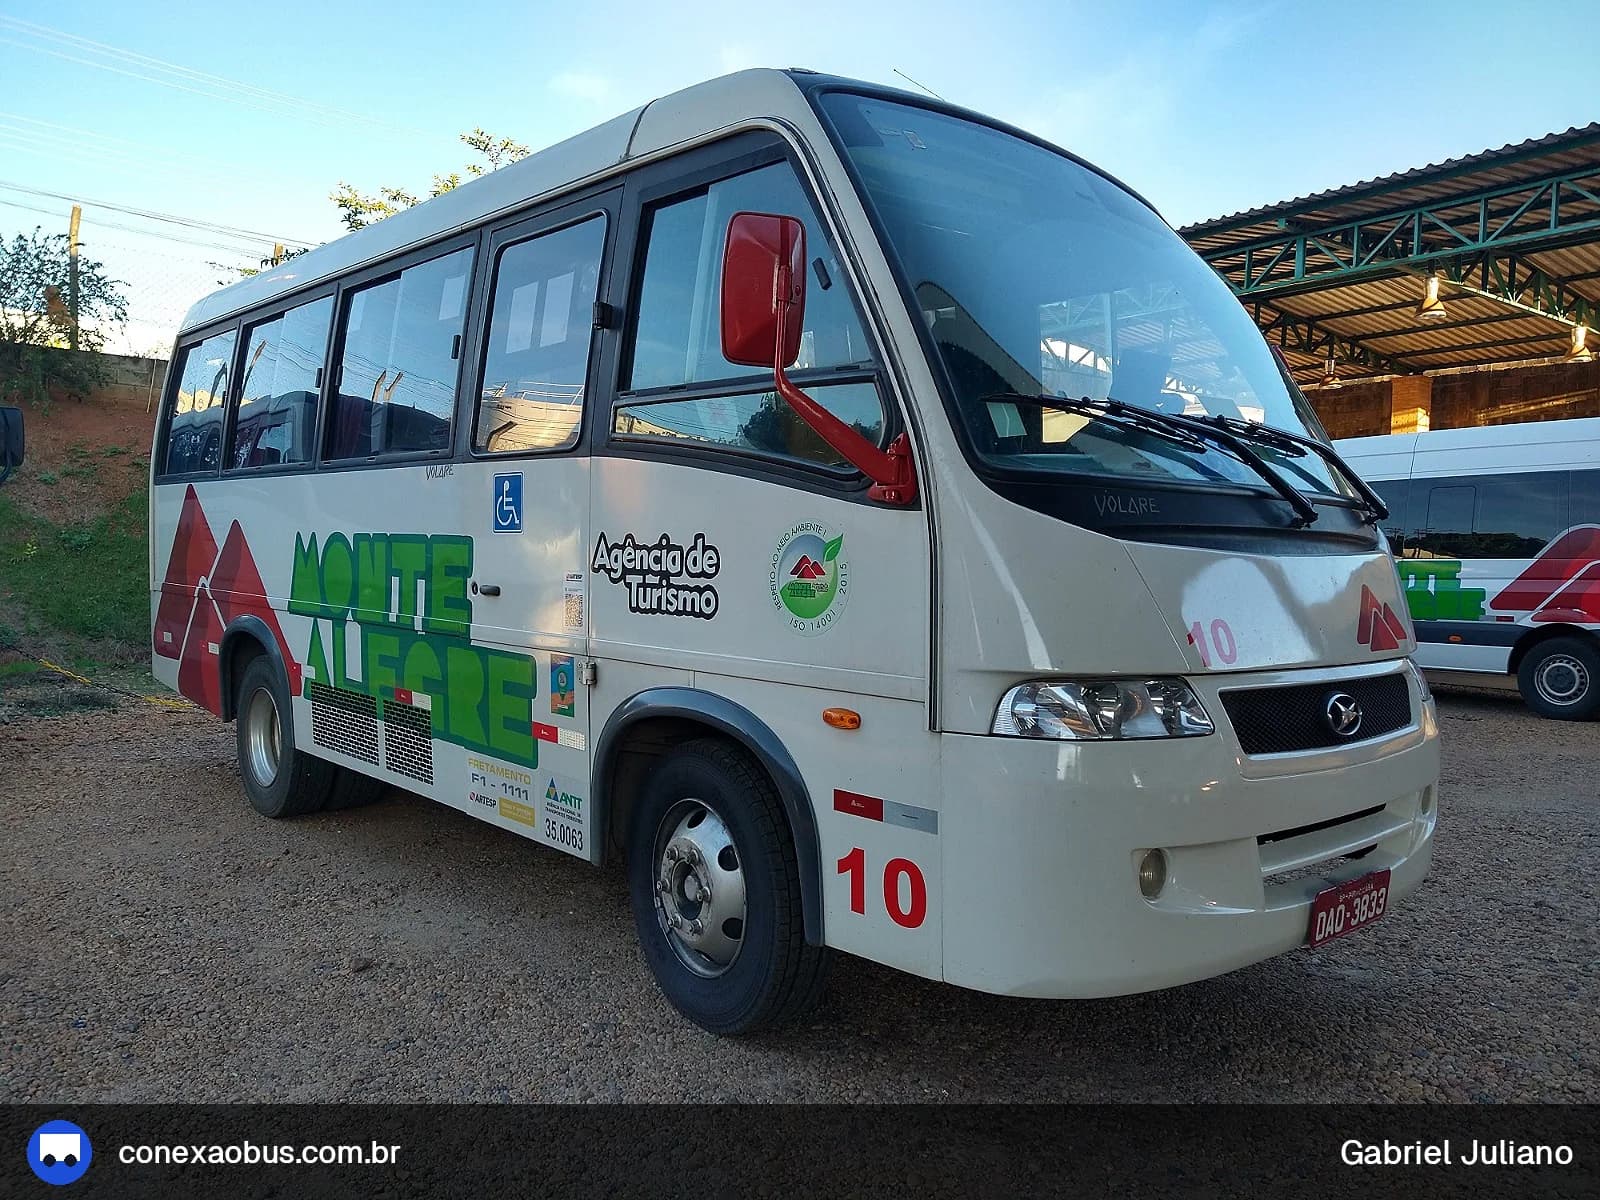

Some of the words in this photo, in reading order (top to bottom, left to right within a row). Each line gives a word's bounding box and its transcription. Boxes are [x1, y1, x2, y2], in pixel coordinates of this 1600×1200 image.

[1093, 494, 1161, 517] VOLARE
[592, 532, 684, 583] Agência
[686, 533, 721, 578] de
[288, 531, 475, 637] MONTE
[625, 576, 719, 619] Turismo
[789, 617, 806, 631] ISO
[811, 609, 836, 631] 14001
[1187, 618, 1237, 667] 10
[303, 617, 539, 769] ALEGRE
[468, 757, 532, 785] FRETAMENTO
[474, 792, 497, 810] ARTESP
[560, 792, 584, 811] ANTT
[545, 817, 584, 852] 35.0063
[837, 847, 928, 930] 10
